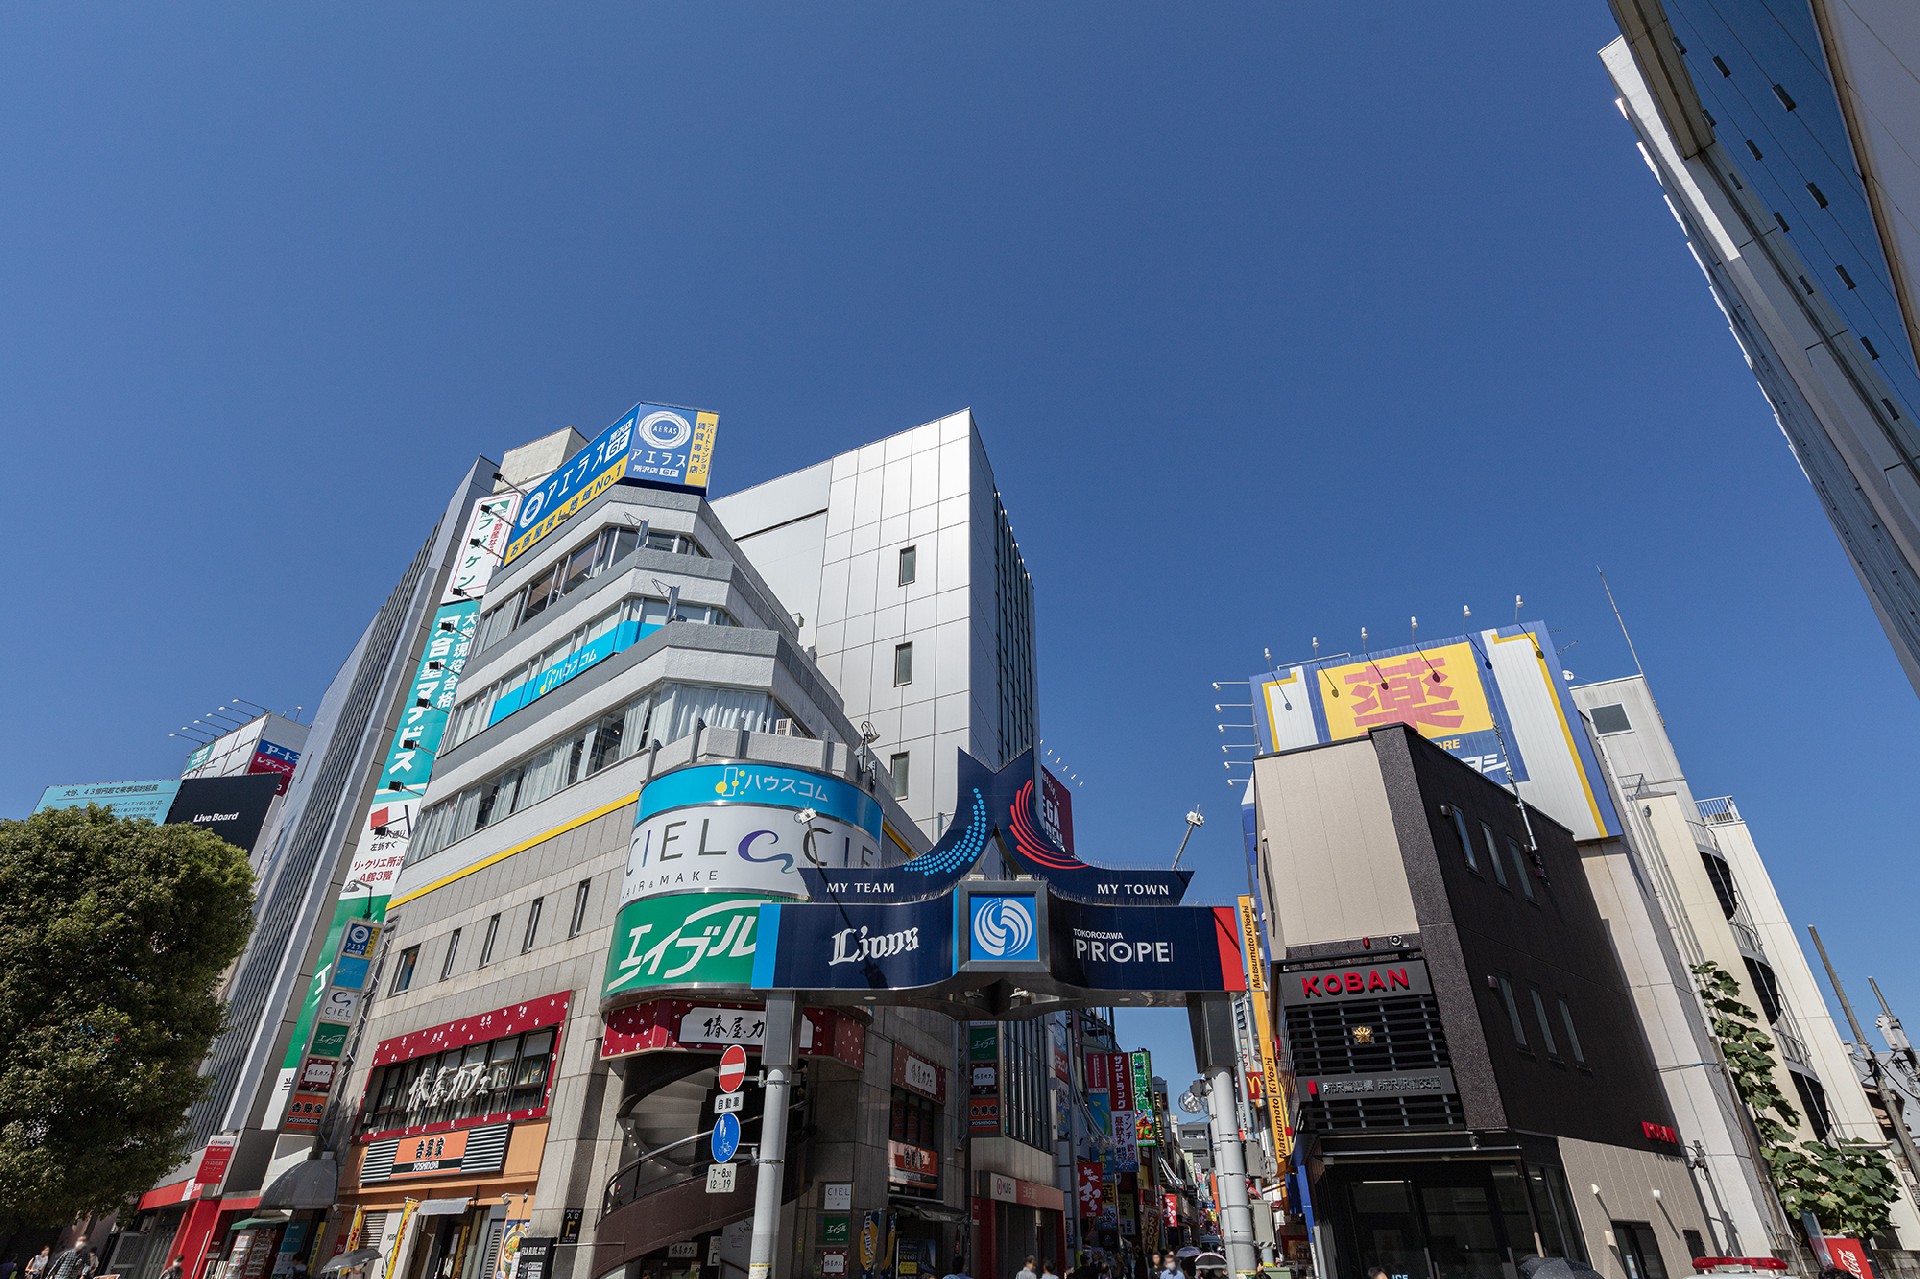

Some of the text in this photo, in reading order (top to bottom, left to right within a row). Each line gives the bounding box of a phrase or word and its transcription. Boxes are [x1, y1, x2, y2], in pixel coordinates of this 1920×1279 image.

[653, 426, 677, 435] AERAS
[631, 449, 686, 468] アエラス
[544, 442, 606, 509] アエラス
[553, 649, 597, 683] ハウスコム
[1344, 657, 1464, 735] 薬
[744, 774, 829, 802] ハウスコム
[193, 811, 239, 823] Live Board
[626, 818, 728, 877] CIEL
[660, 870, 718, 886] MAKE
[827, 883, 895, 894] MY TEAM
[1097, 884, 1169, 896] MY TOWN
[1073, 927, 1124, 939] TOKOROZAWA
[607, 900, 768, 992] エイブル
[828, 925, 919, 966] Lions
[1075, 941, 1171, 963] PROPE
[1248, 940, 1261, 989] Matsumoto
[1301, 967, 1410, 996] KOBAN
[325, 1006, 351, 1018] CIEL
[1114, 1055, 1126, 1110] サンドラッグ
[718, 1096, 740, 1110] 自動車
[1272, 1098, 1287, 1158] Matsumoto
[414, 1136, 446, 1160] 吉野家
[710, 1179, 731, 1189] 12-19
[828, 1188, 850, 1196] CIEL
